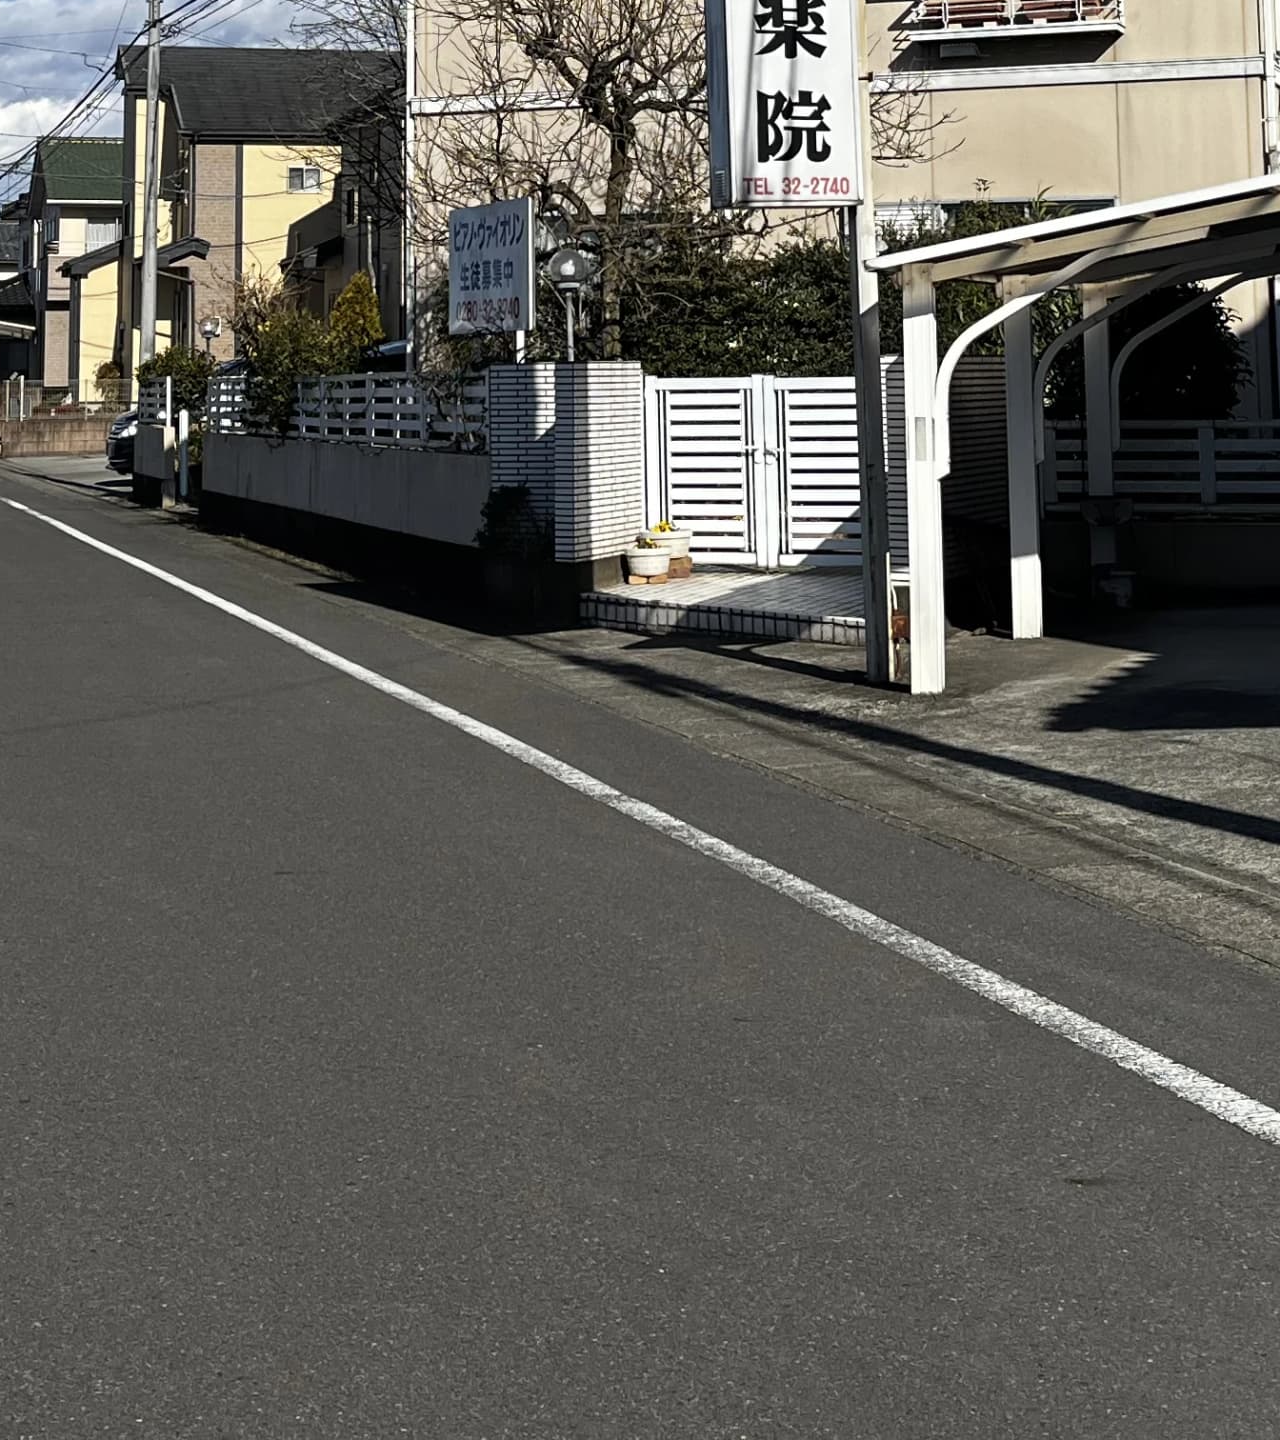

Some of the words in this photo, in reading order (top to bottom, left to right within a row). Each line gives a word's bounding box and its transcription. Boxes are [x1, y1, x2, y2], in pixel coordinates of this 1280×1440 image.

[742, 177, 774, 196] TEL
[782, 176, 850, 196] 32-2740
[459, 259, 514, 292] 生徒募集中
